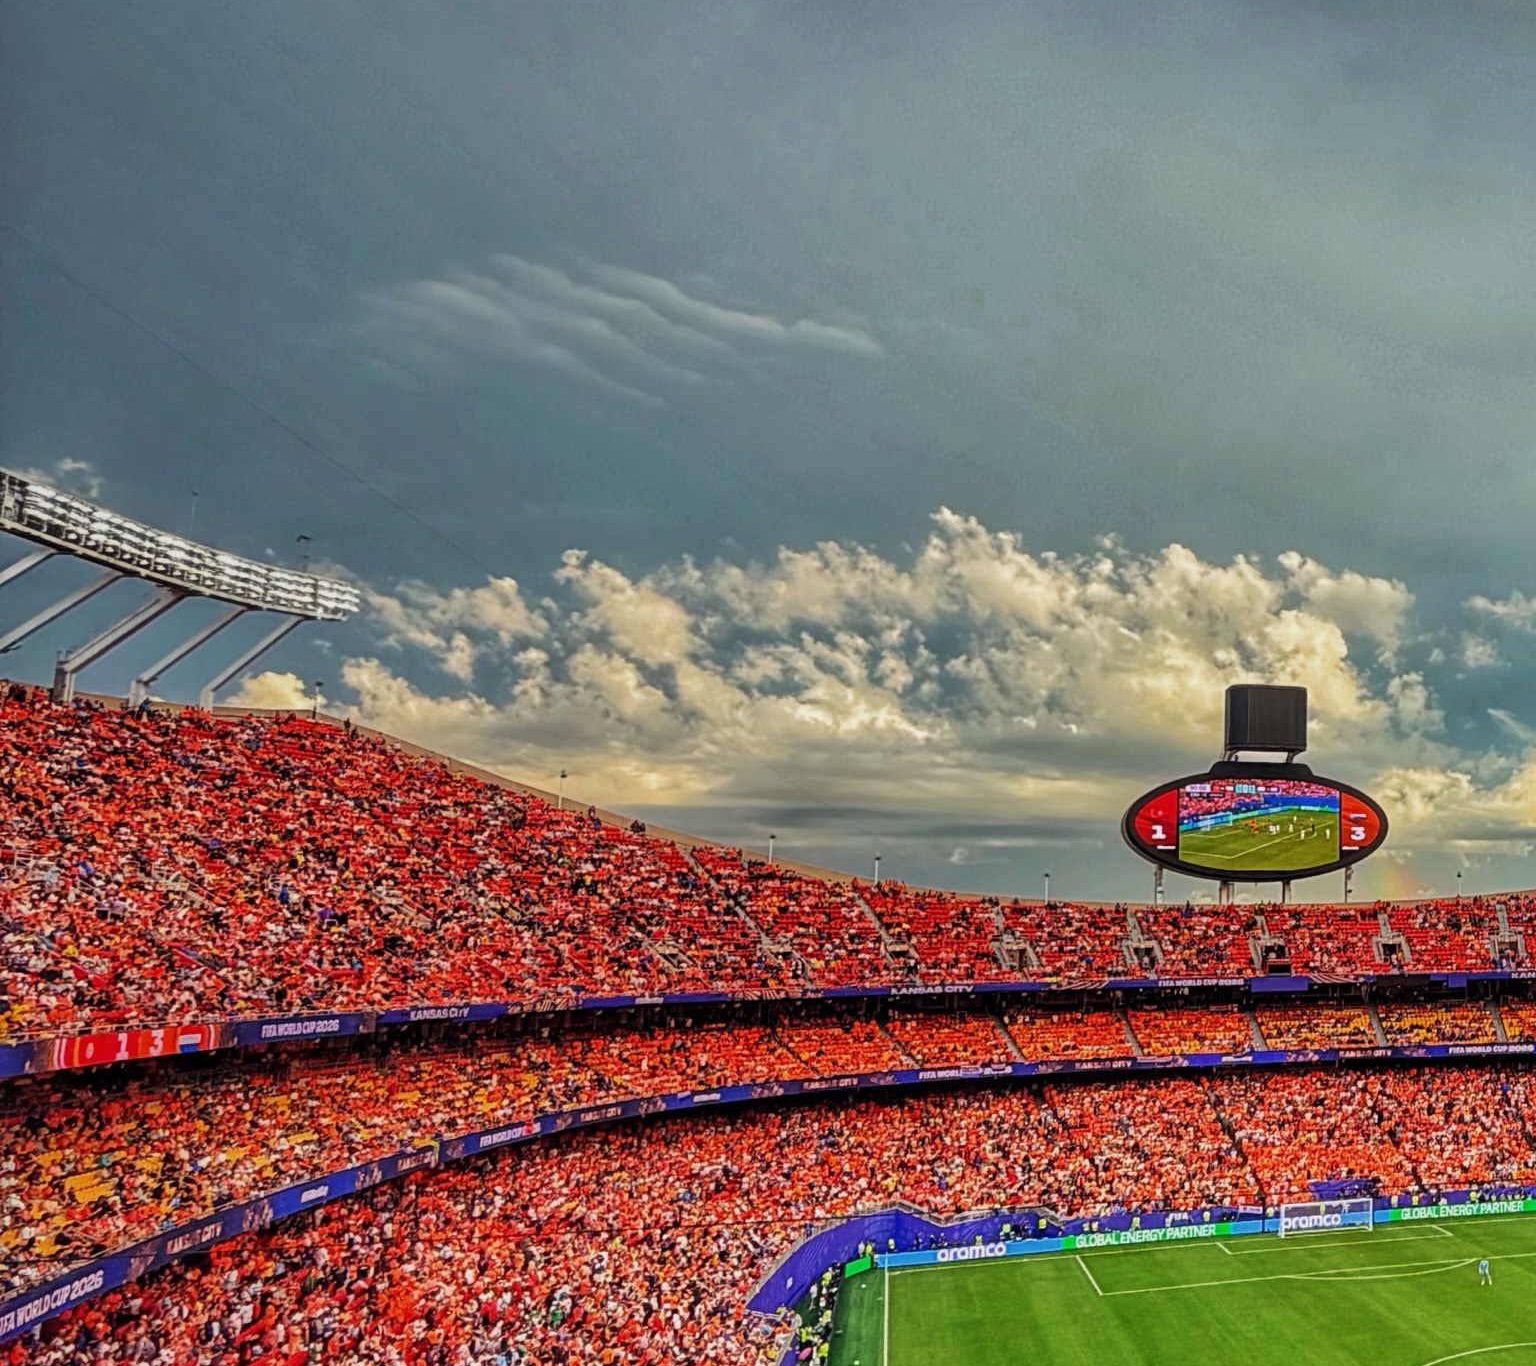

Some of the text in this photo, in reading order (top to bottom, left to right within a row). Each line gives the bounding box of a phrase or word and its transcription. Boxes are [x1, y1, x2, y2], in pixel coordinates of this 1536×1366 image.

[1151, 824, 1166, 840] 1
[1350, 826, 1366, 840] 3
[891, 985, 974, 995] KANSAS CITY
[410, 1008, 470, 1021] KANSAS CITY
[316, 1019, 339, 1032] 2026
[116, 1029, 164, 1061] 1 3
[1448, 1046, 1465, 1055] FIFA
[1466, 1045, 1491, 1054] WORLD
[1492, 1045, 1508, 1053] CUP
[937, 1068, 962, 1079] WORL
[1401, 1200, 1524, 1220] GLOBAL ENERGY PARTNER
[1282, 1213, 1341, 1230] aramco
[1075, 1224, 1216, 1248] GLOBAL ENERGY PARTNER
[937, 1242, 1007, 1262] aramco
[16, 1295, 50, 1327] WORLD
[50, 1284, 71, 1309] CUP
[71, 1270, 104, 1301] 2026
